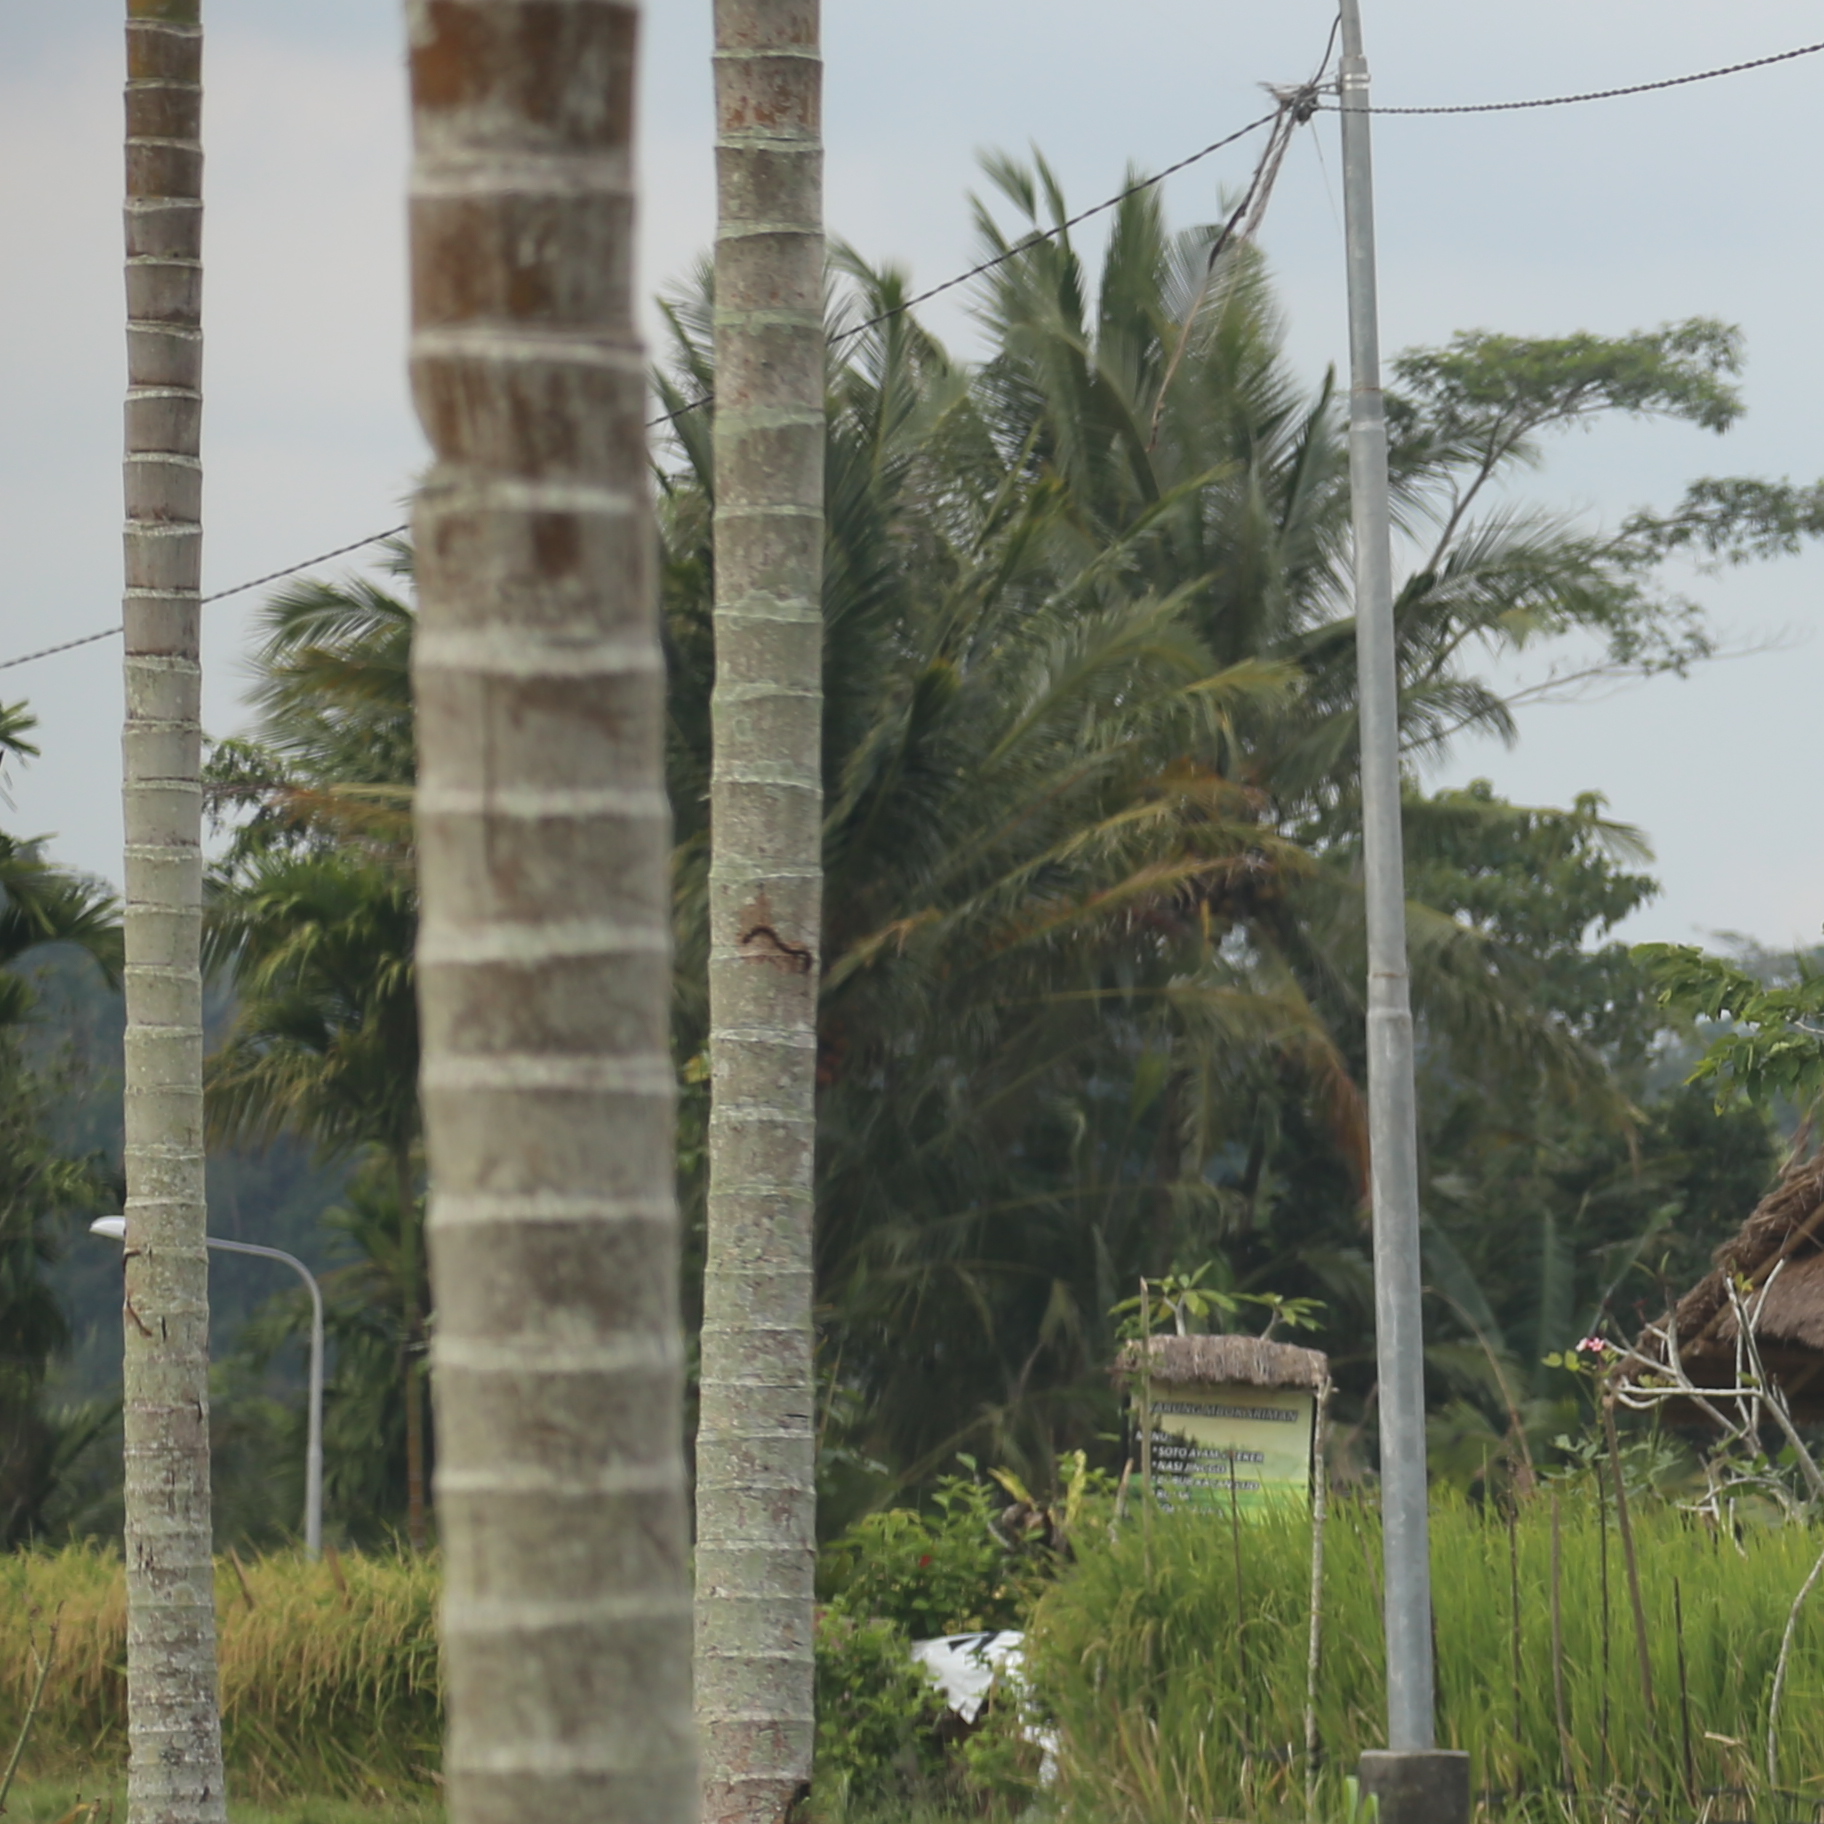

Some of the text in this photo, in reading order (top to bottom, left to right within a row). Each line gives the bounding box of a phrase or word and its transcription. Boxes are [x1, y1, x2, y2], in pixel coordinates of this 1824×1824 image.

[1149, 1402, 1201, 1415] ARUNG
[1159, 1446, 1187, 1459] SOTO
[1230, 1450, 1264, 1463] EKER
[1157, 1460, 1183, 1472] NASI
